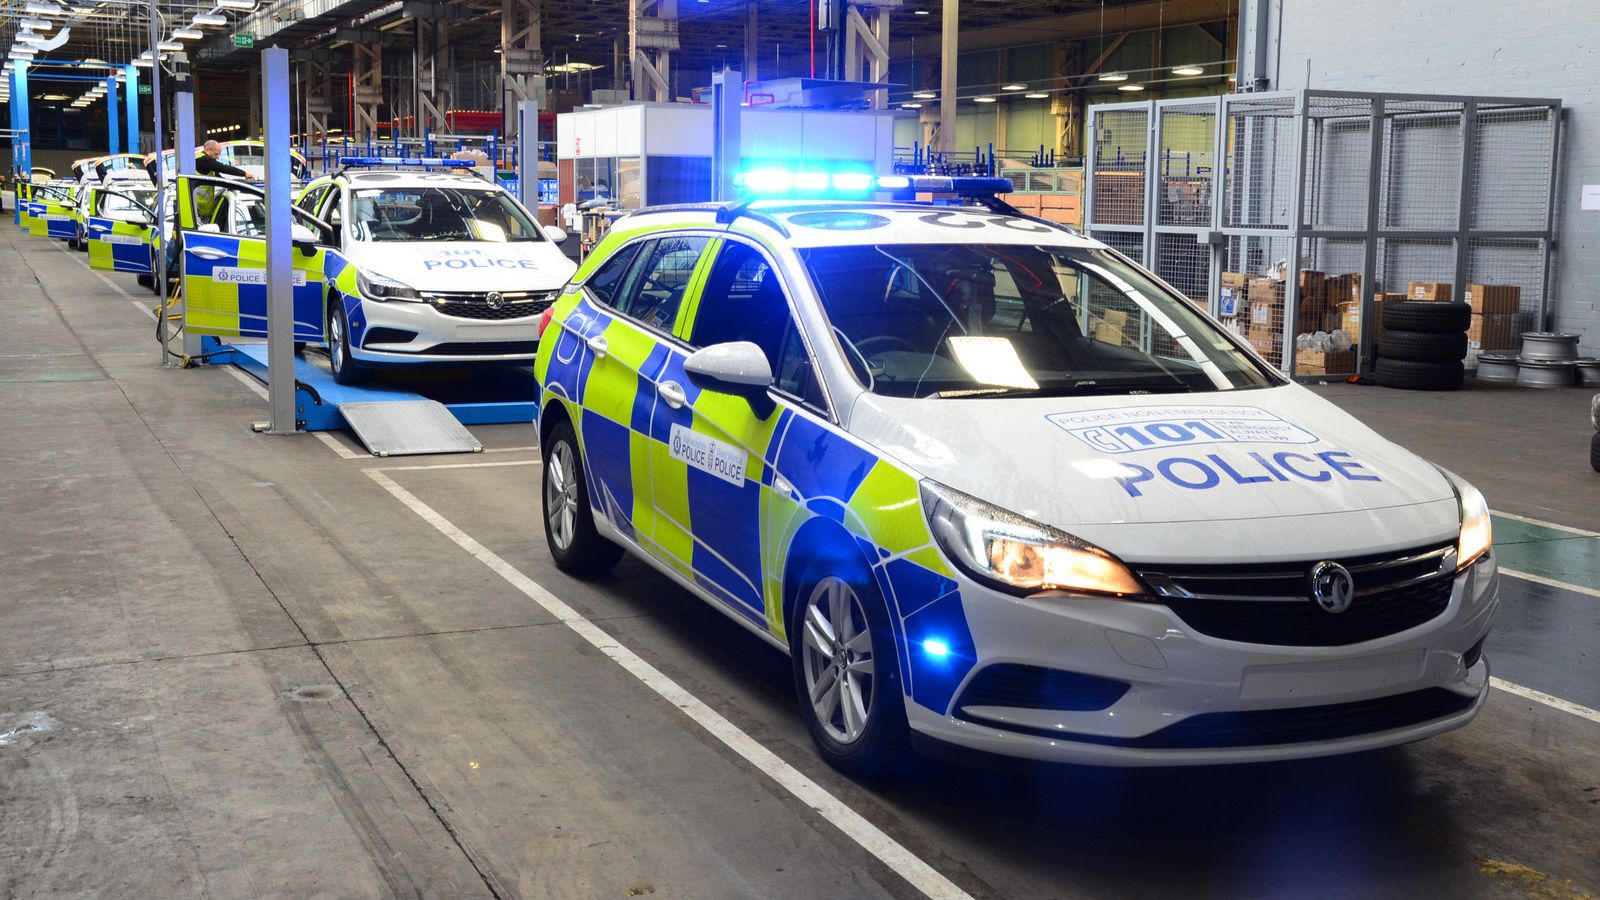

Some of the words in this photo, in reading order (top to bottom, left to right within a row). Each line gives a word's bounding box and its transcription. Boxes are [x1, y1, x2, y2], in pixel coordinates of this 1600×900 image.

[424, 259, 538, 270] POLICE
[230, 274, 260, 282] POLICE
[1058, 412, 1119, 425] POLICE
[1115, 421, 1224, 446] 101
[682, 444, 705, 465] POLICE
[714, 457, 741, 480] POLICE
[1113, 451, 1382, 498] POLICE
